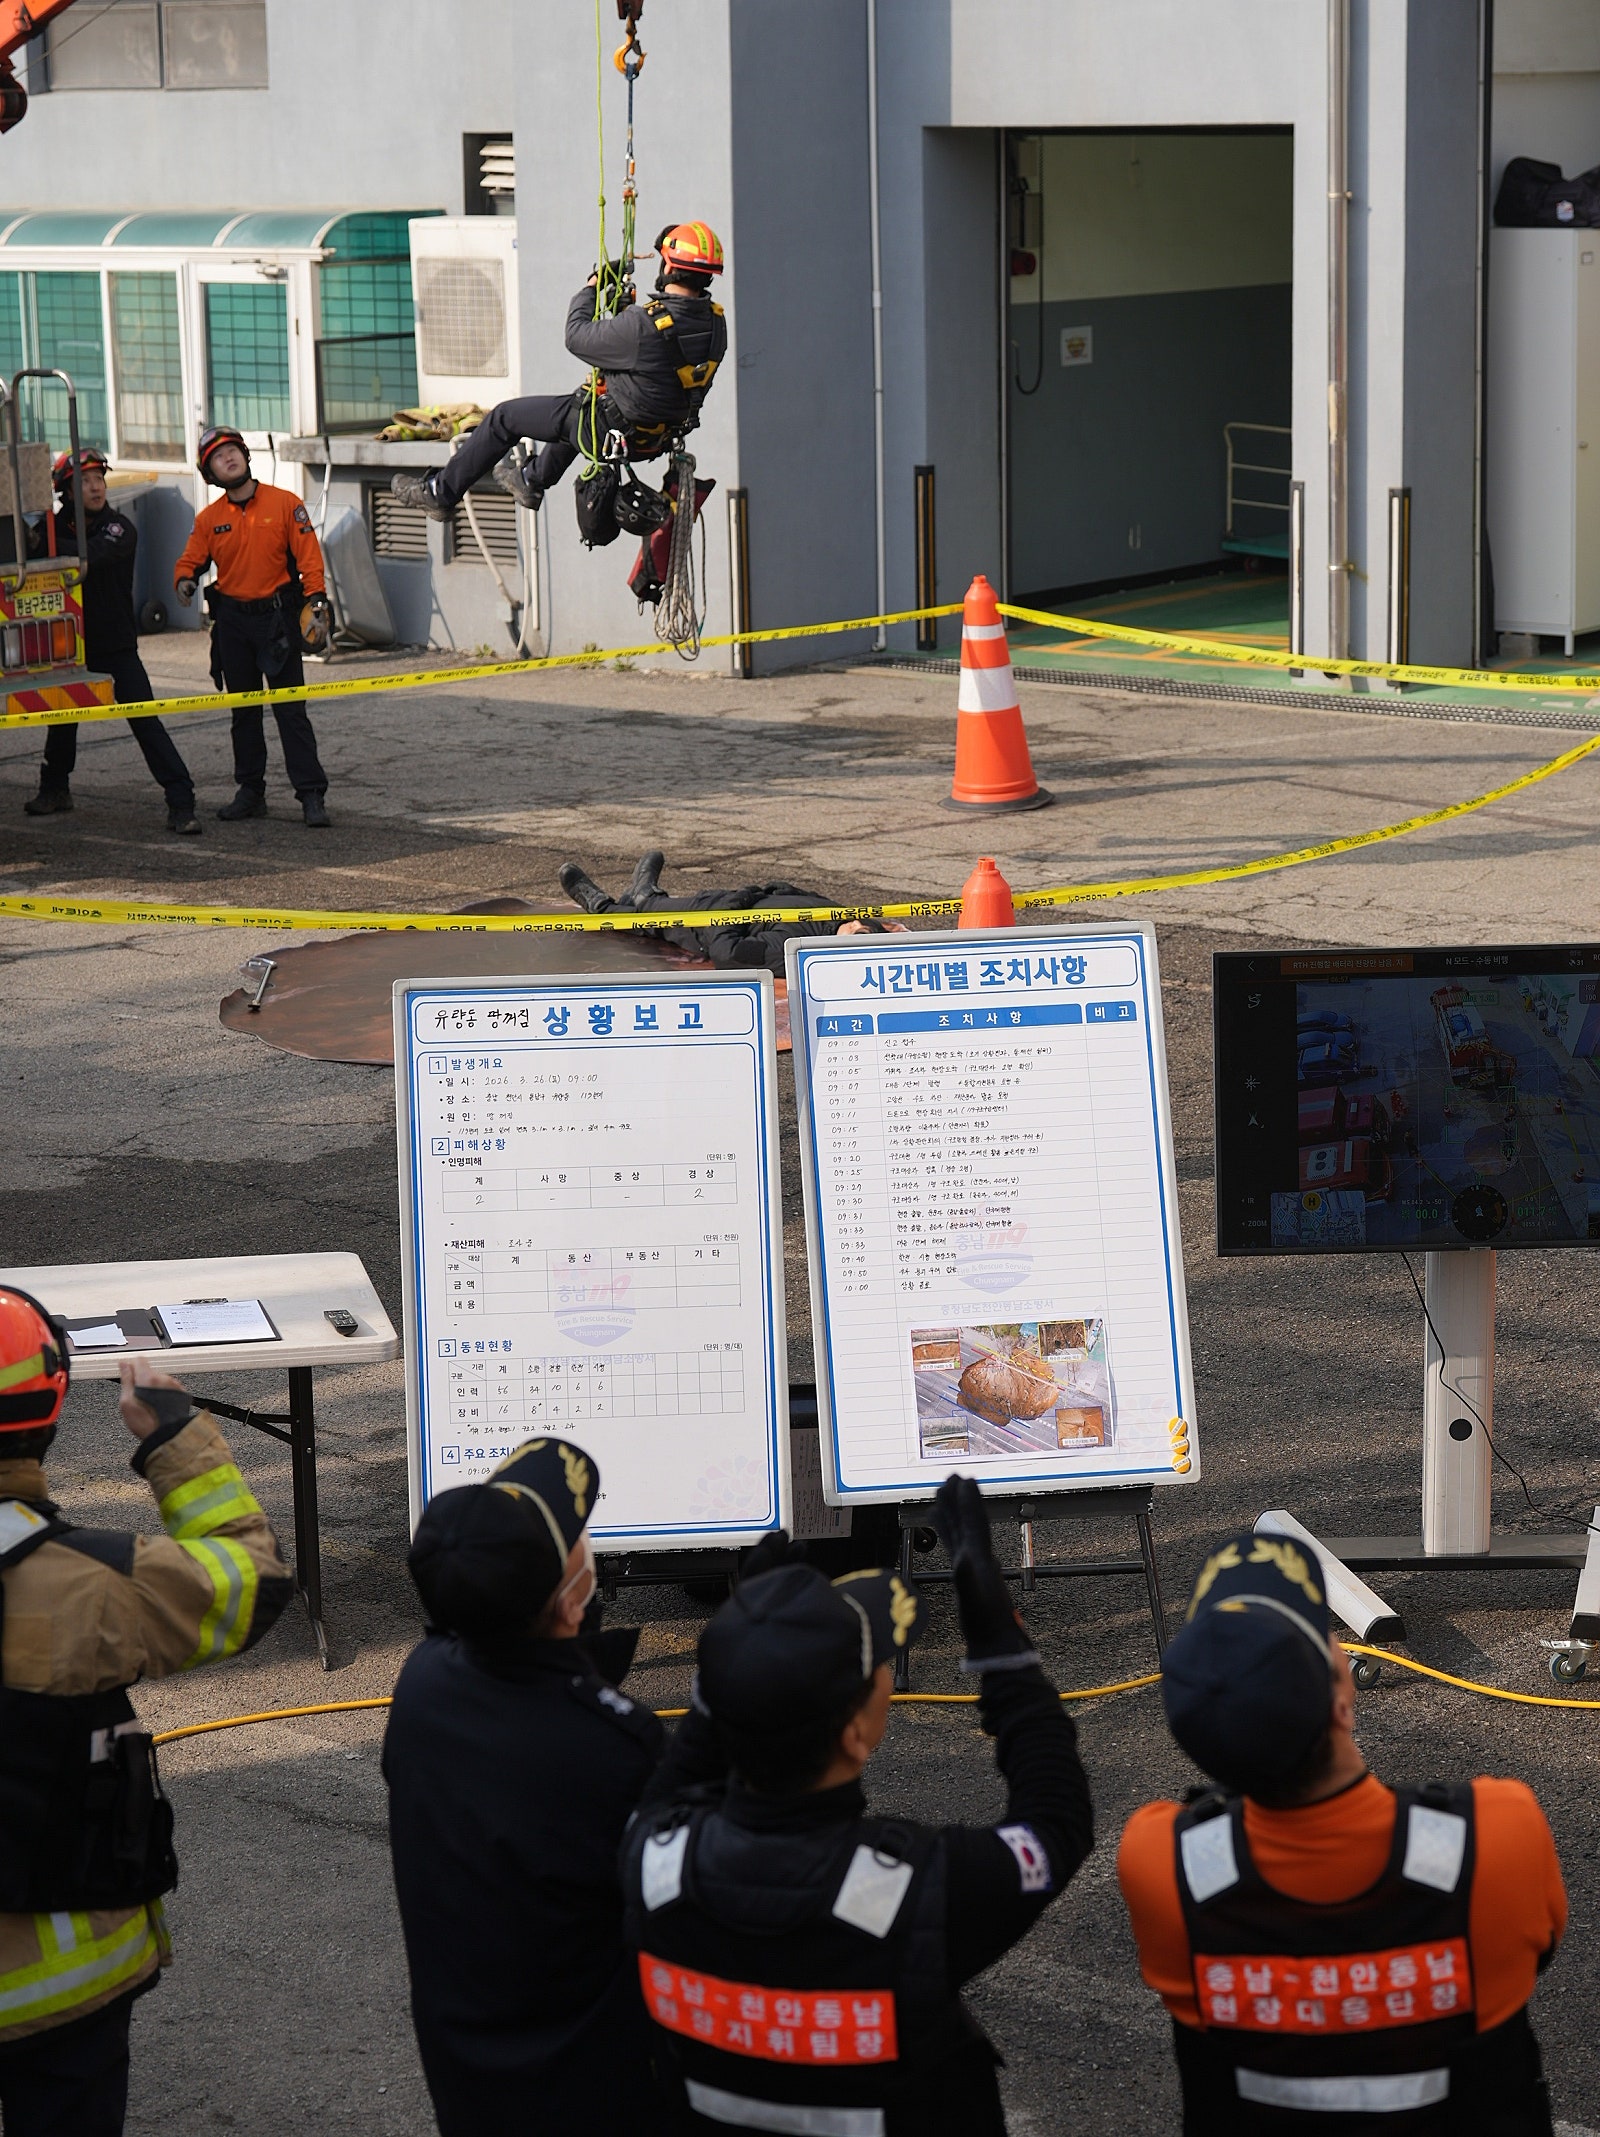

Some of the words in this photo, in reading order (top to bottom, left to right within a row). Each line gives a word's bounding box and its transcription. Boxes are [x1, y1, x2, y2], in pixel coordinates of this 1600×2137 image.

[1493, 955, 1509, 965] 비행
[860, 958, 968, 994] 시간대별
[979, 955, 1088, 989] 조치사항
[433, 1008, 478, 1031] 유량동
[486, 1007, 531, 1030] 땅꺼짐
[542, 1003, 704, 1036] 상황보고
[827, 1019, 863, 1032] 시간
[938, 1011, 1022, 1027] 조치사항
[1095, 1004, 1130, 1019] 비고
[451, 1056, 505, 1071] 발생개요
[453, 1138, 506, 1151] 피해상황
[447, 1157, 482, 1168] 인명피해
[475, 1176, 483, 1186] 계
[540, 1173, 567, 1184] 사망
[613, 1171, 640, 1181] 중상
[688, 1168, 714, 1179] 경상
[474, 1194, 485, 1205] 2
[693, 1187, 705, 1199] 2
[450, 1239, 485, 1250] 재산피해
[511, 1255, 520, 1265] 계
[568, 1253, 591, 1263] 동산
[625, 1250, 660, 1261] 부동산
[694, 1248, 721, 1259] 기타
[453, 1279, 475, 1290] 금액
[454, 1300, 476, 1310] 내용
[460, 1339, 513, 1353] 동원현황
[498, 1365, 507, 1374] 계
[456, 1387, 479, 1397] 인력
[457, 1407, 479, 1418] 장비
[463, 1448, 485, 1460] 주요
